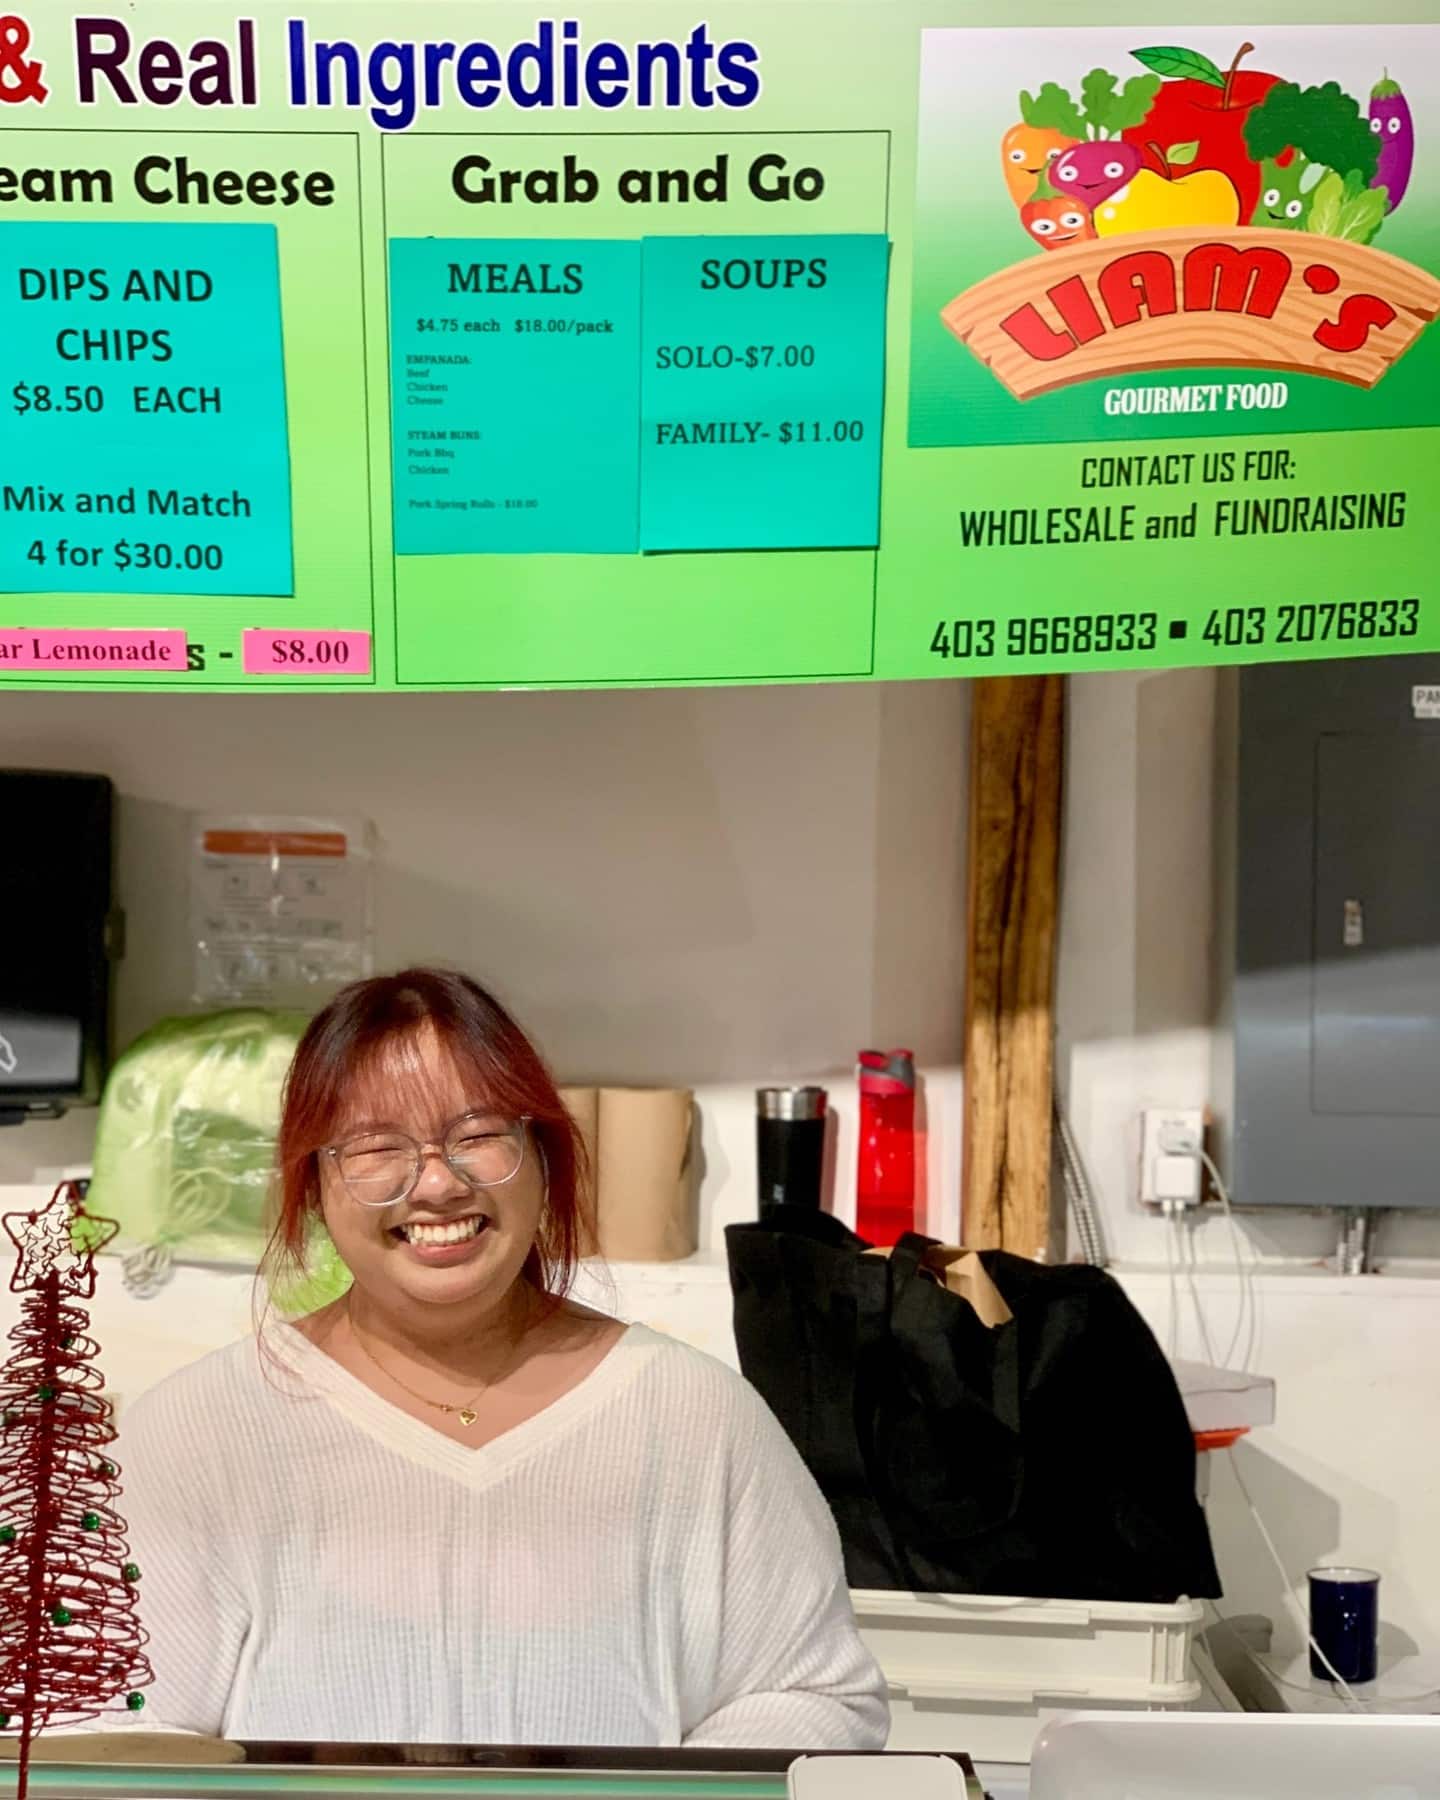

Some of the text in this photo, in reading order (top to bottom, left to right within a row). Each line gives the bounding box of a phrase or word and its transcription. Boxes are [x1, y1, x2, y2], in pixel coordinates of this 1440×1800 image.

[0, 16, 761, 130] & Real Ingredients
[134, 155, 335, 206] Cheese
[452, 153, 825, 203] Grab and Go
[19, 268, 214, 302] DIPS AND
[447, 263, 583, 294] MEALS
[700, 258, 828, 290] SOUPS
[416, 318, 614, 335] $4.75 each $18.00/pack
[55, 329, 173, 362] CHIPS
[656, 345, 816, 370] SOLO-$7.00
[12, 381, 222, 415] $8.50 EACH
[1104, 382, 1288, 415] GOURMET FOOD
[656, 420, 864, 446] FAMILY- $11.00
[1081, 449, 1296, 489] CONTACT US FOR:
[2, 485, 251, 517] Mix and Match
[960, 492, 1406, 547] WHOLESALE and FUNDRAISING
[27, 539, 223, 571] 4 for $30.00
[930, 599, 1419, 658] 403 9668933 403 2076833
[32, 638, 171, 661] Lemonade
[272, 639, 349, 664] $8.00
